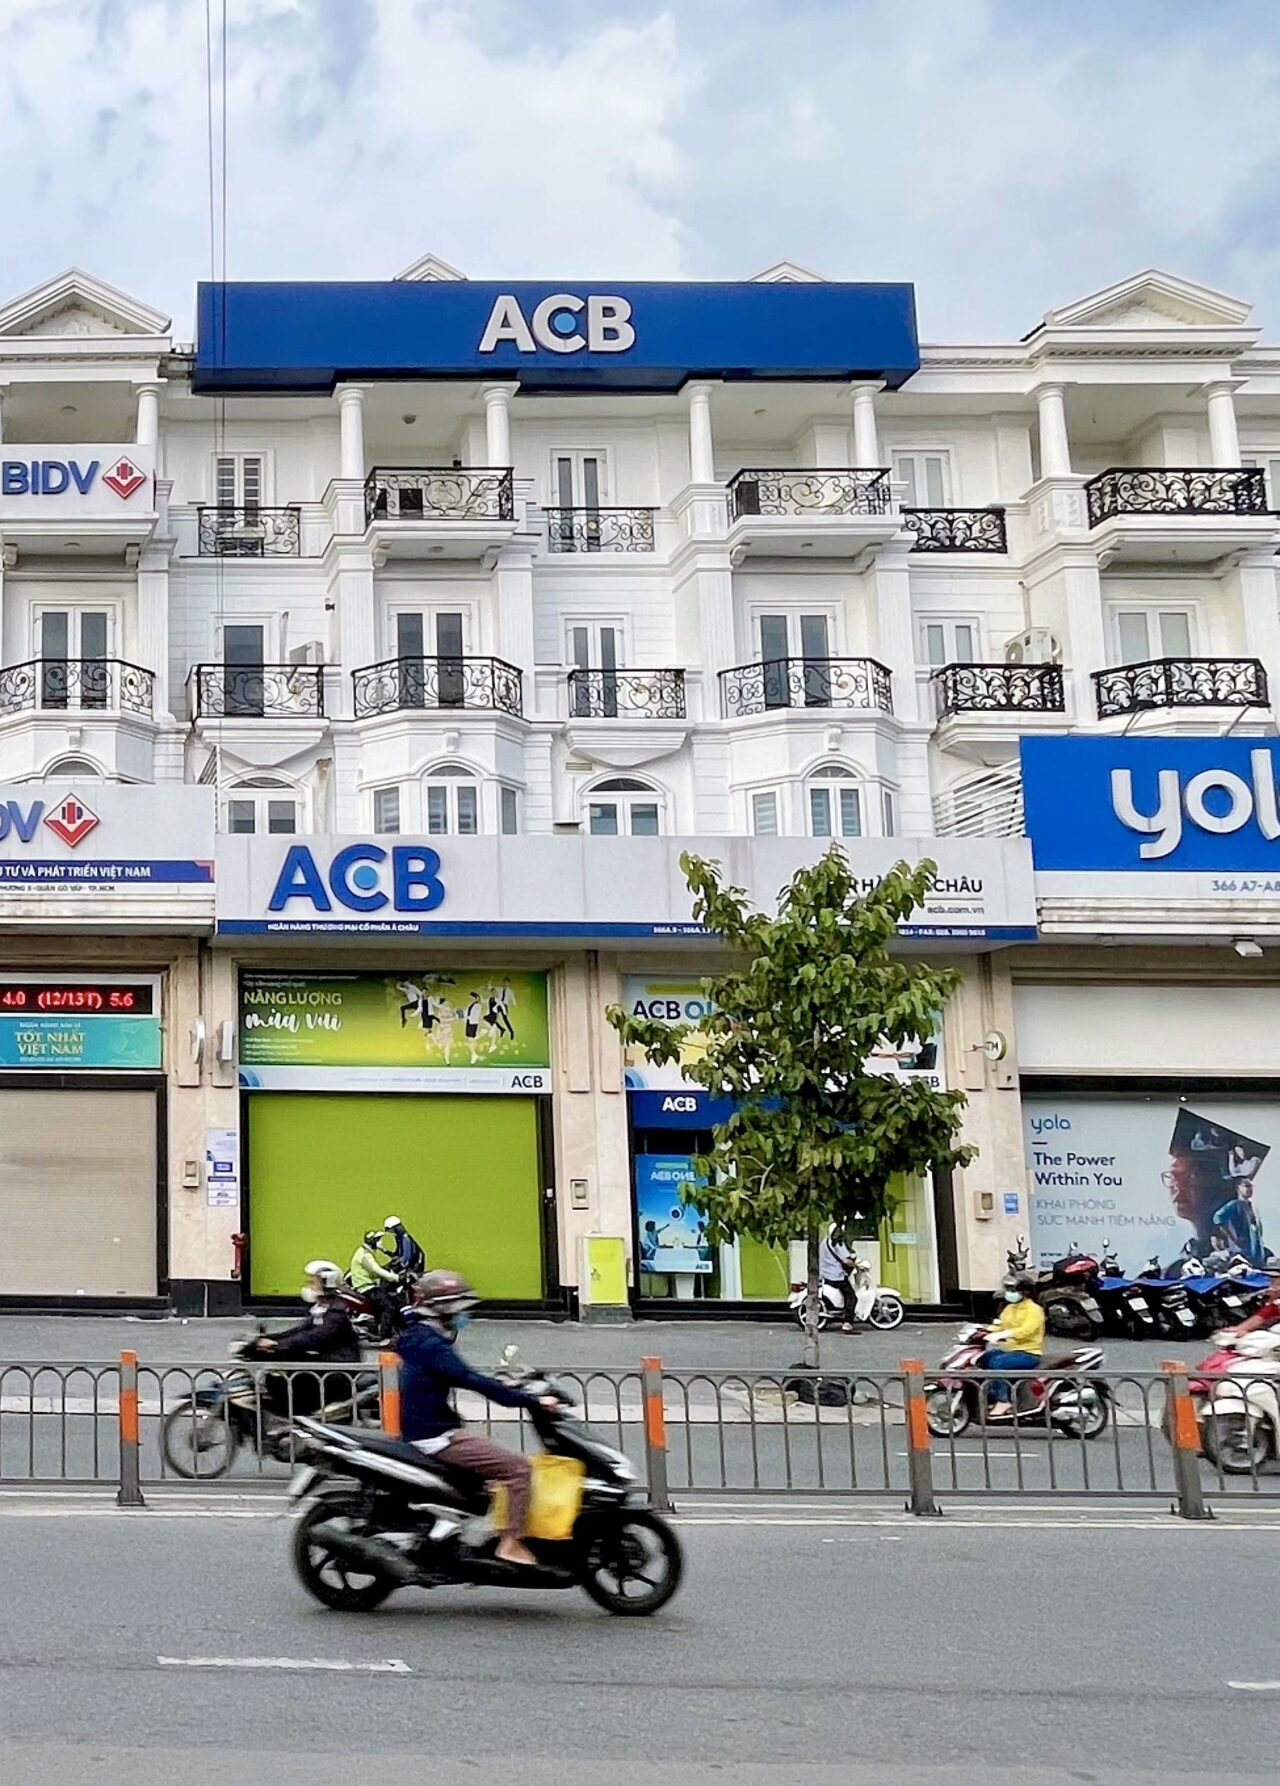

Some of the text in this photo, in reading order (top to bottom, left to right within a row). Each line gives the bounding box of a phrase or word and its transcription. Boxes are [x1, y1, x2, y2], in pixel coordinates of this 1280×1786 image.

[478, 293, 637, 353] ACB
[2, 460, 100, 496] BIDV
[1110, 748, 1280, 859] yol
[22, 864, 37, 877] VÀ
[38, 864, 67, 877] PHÁT
[99, 866, 124, 880] VIỆT
[125, 867, 151, 877] NAM
[268, 843, 446, 913] ACB
[933, 875, 983, 893] CHÂU
[1212, 880, 1237, 892] 366
[2, 991, 27, 1006] 4.0
[110, 993, 134, 1008] 5.6
[244, 989, 342, 1007] NĂNG LƯỢNG
[633, 1000, 680, 1020] ACB
[15, 1028, 86, 1042] TỐT NHẤT
[18, 1043, 84, 1057] VIỆT NAM
[511, 1075, 544, 1089] ACB
[662, 1096, 697, 1112] ACB
[1031, 1113, 1071, 1135] yola
[1033, 1152, 1116, 1166] The Power
[1035, 1171, 1122, 1186] Within You
[1037, 1200, 1066, 1210] KHAI
